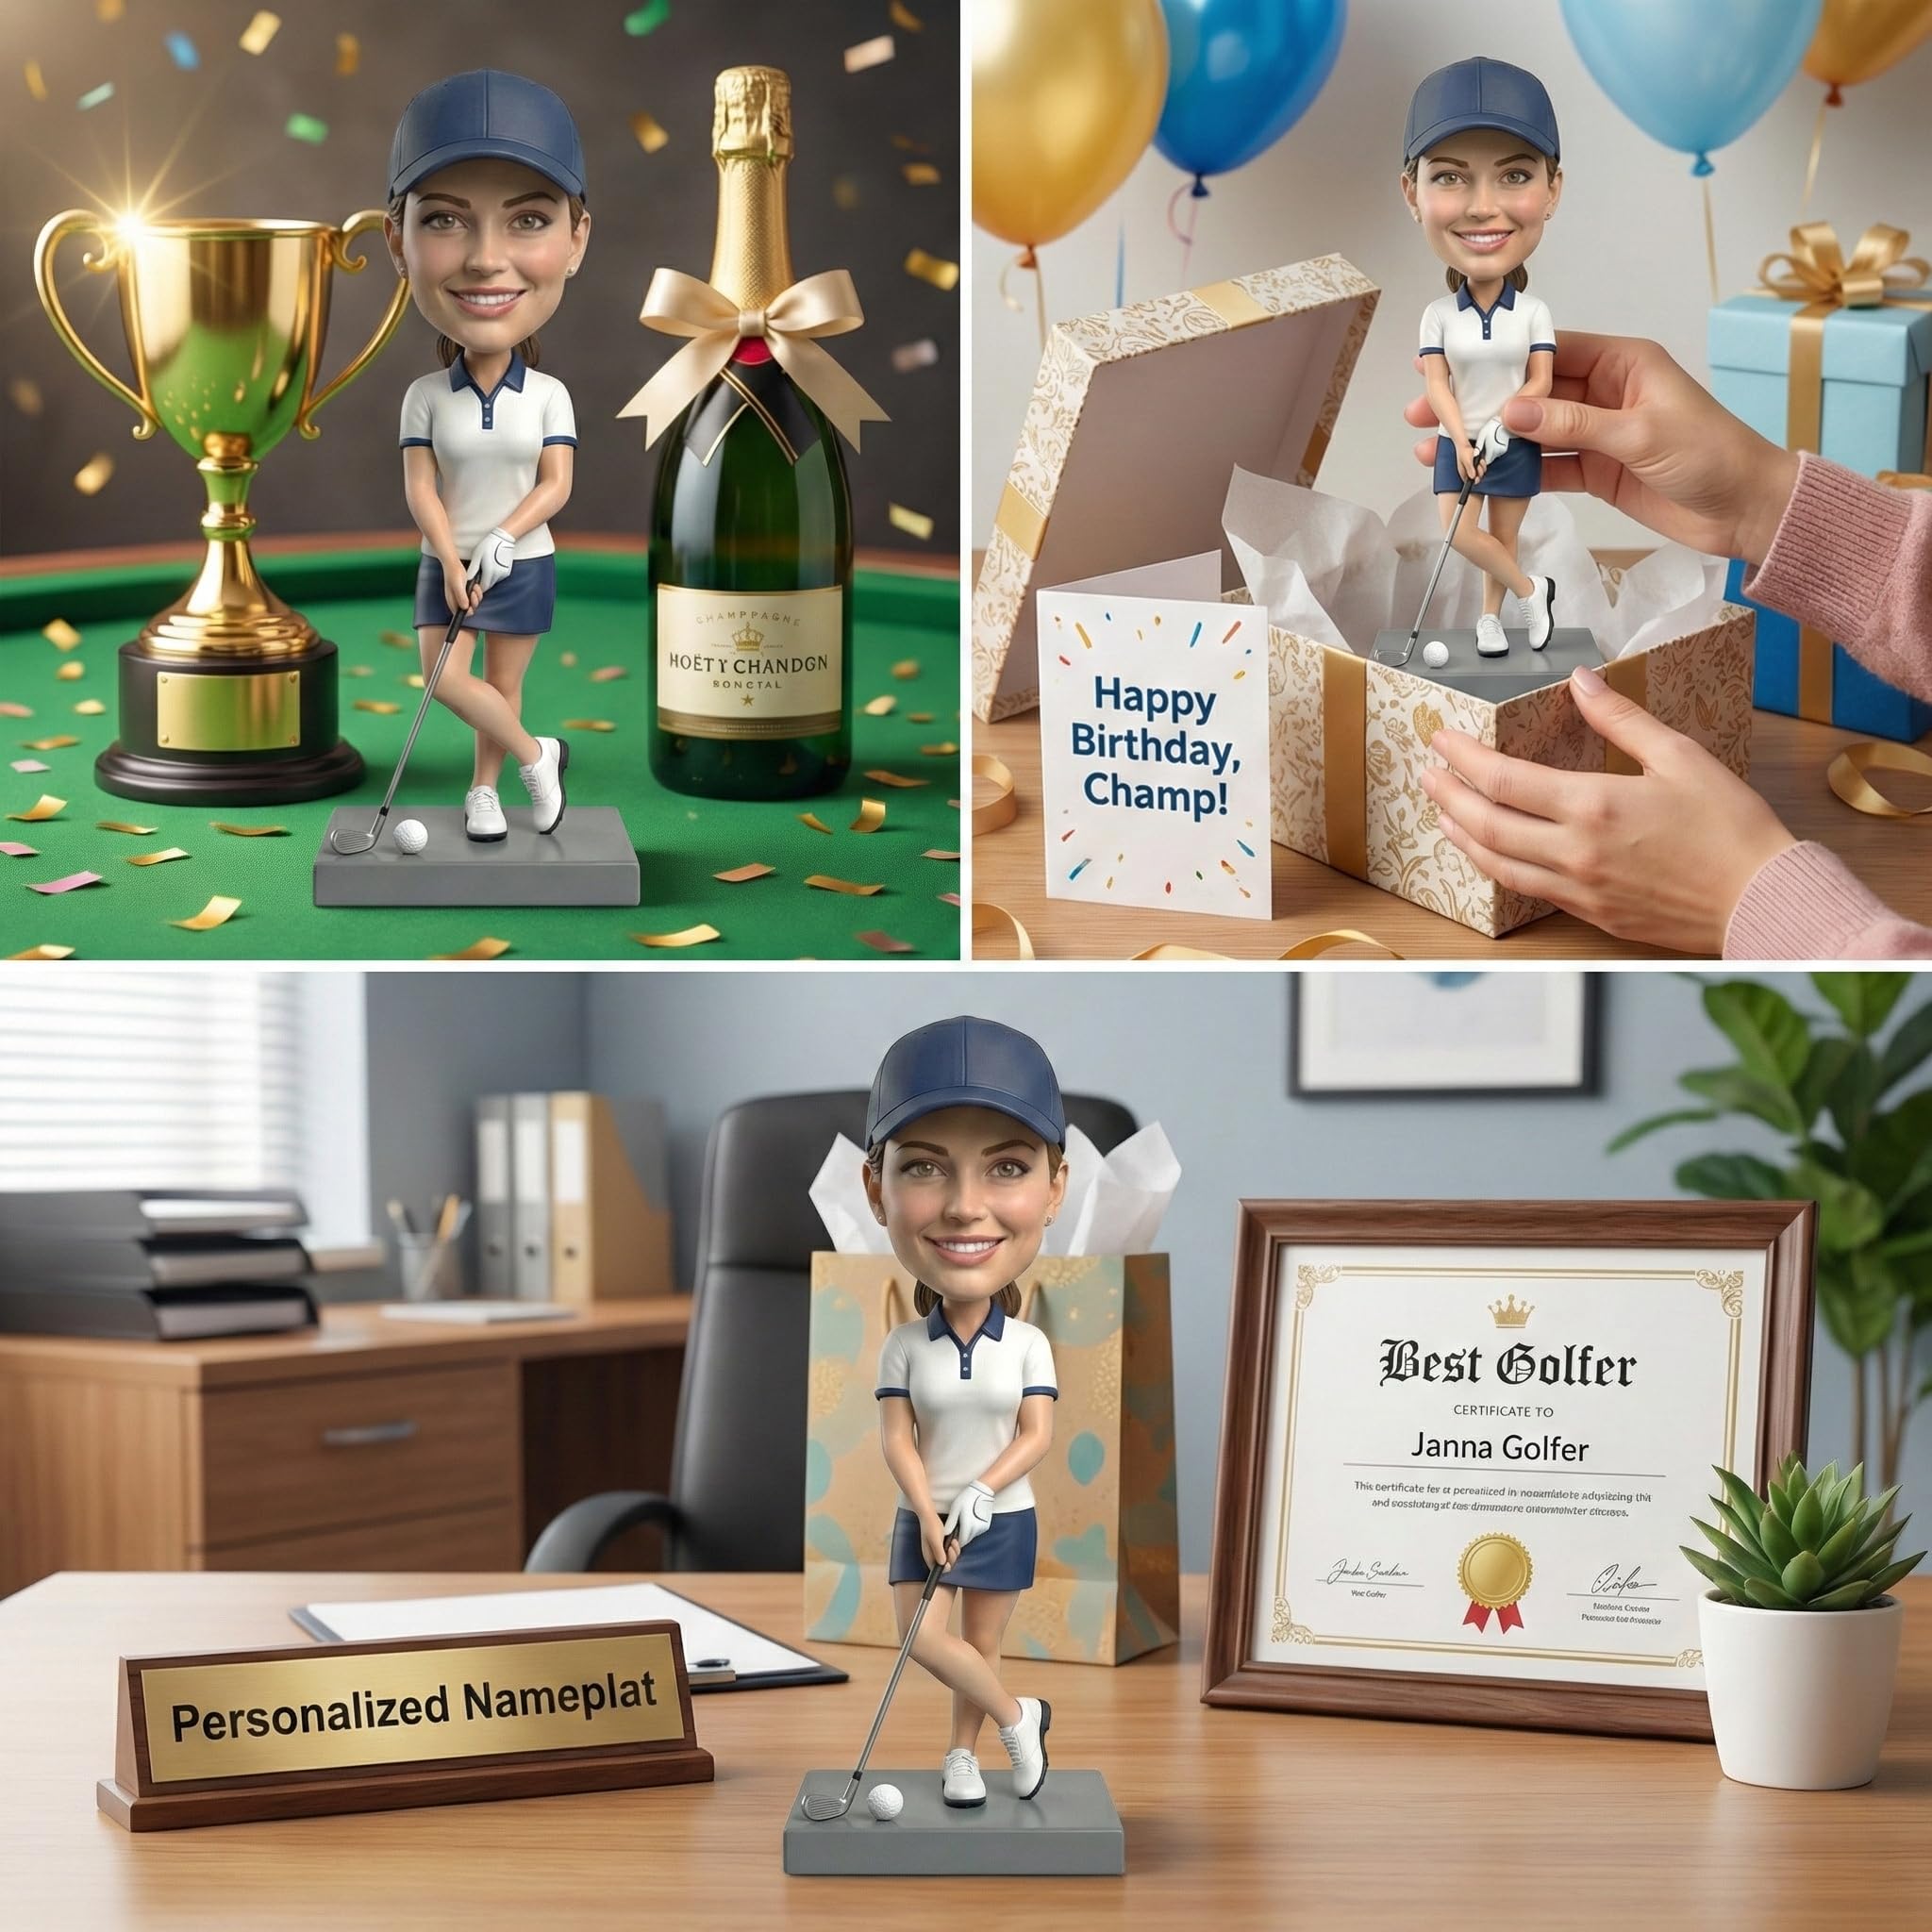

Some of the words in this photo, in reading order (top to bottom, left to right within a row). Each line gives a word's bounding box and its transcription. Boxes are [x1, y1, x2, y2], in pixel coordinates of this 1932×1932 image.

[1095, 675, 1217, 725] Happy
[1072, 723, 1241, 775] Birthday,
[1084, 772, 1228, 823] Champ!
[1379, 1339, 1482, 1387] Best
[1496, 1342, 1638, 1387] Golfer
[1454, 1405, 1531, 1417] CERTIFICATE
[1536, 1407, 1554, 1418] TO
[1411, 1431, 1492, 1458] Janna
[1503, 1434, 1590, 1461] Golfer
[172, 1685, 450, 1742] Personalized
[463, 1671, 658, 1721] Nameplat
